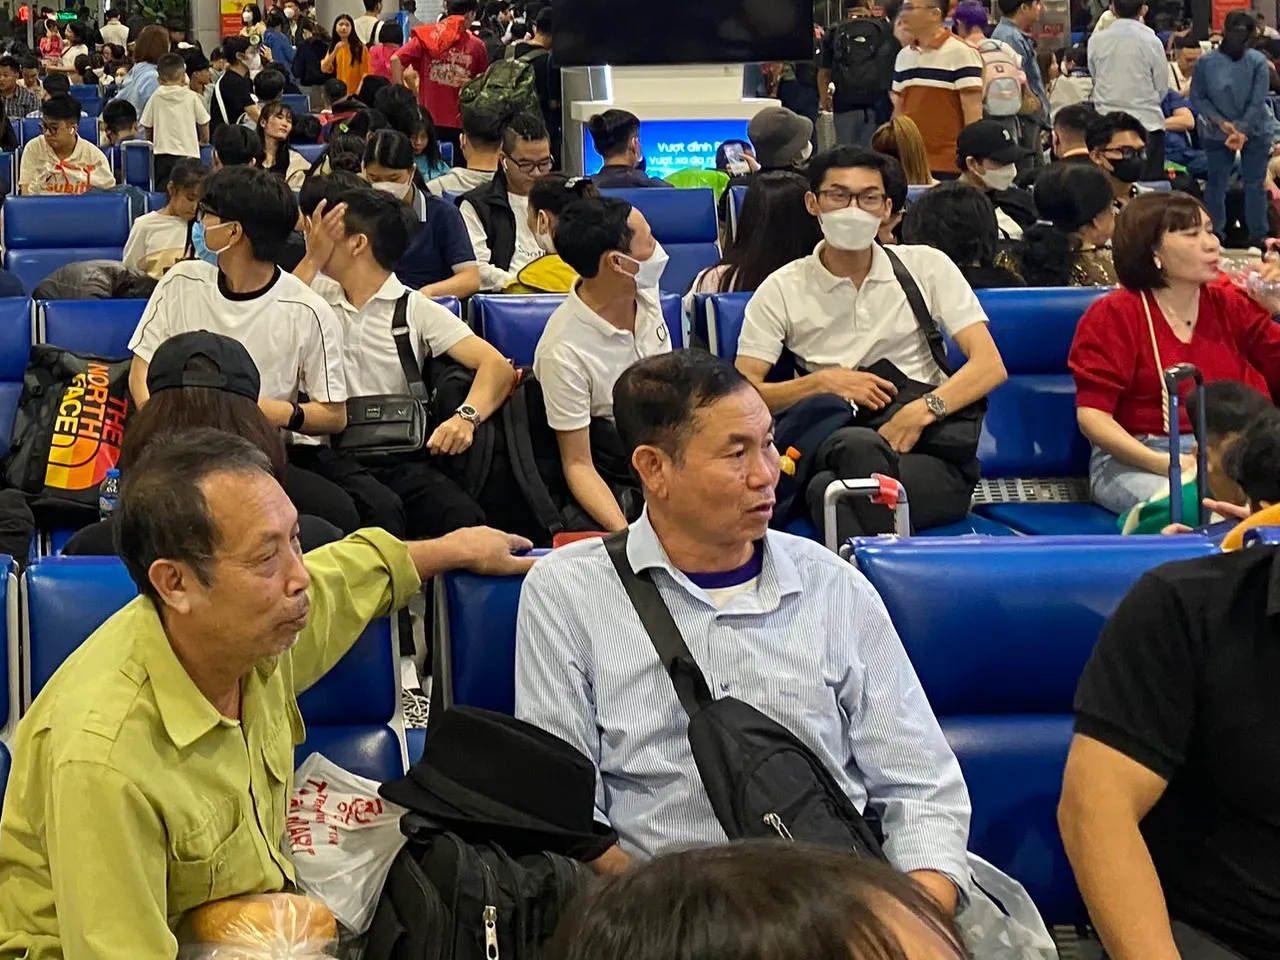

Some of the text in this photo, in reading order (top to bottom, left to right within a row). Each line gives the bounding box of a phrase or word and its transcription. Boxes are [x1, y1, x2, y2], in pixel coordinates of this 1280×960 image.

[54, 373, 88, 434] FACE
[78, 362, 111, 439] NORTH
[102, 396, 128, 448] THE
[287, 817, 316, 856] MART
